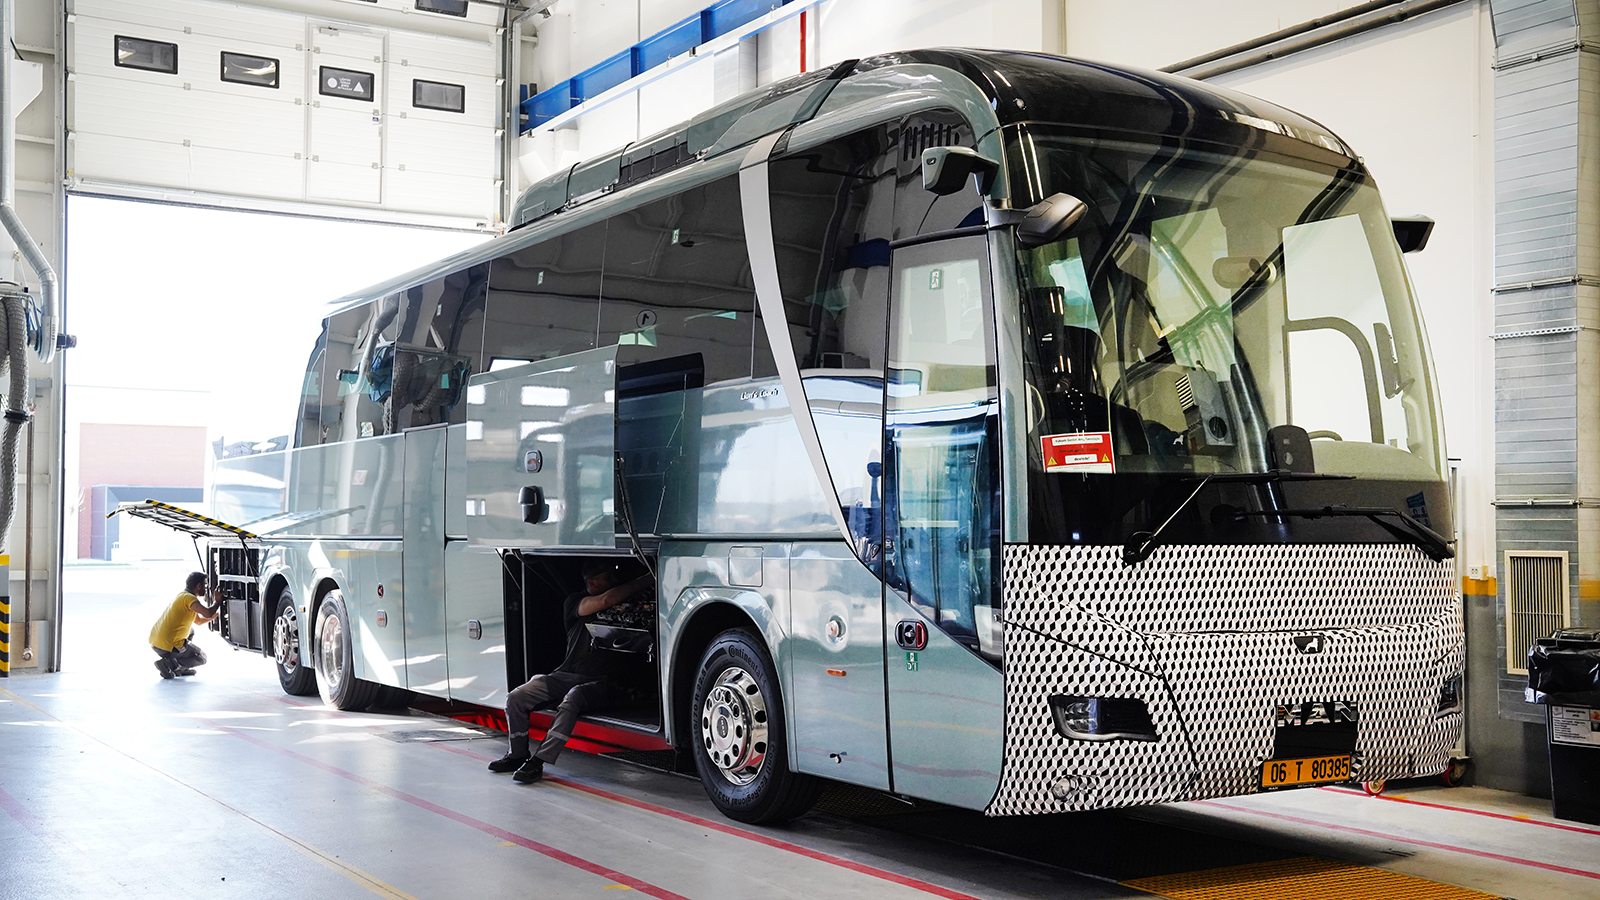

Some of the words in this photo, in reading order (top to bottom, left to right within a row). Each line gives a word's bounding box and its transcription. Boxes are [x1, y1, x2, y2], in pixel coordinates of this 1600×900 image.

[728, 644, 763, 681] Continental
[696, 668, 707, 692] 22.5
[694, 693, 700, 702] R
[1277, 701, 1357, 727] MAN
[1271, 763, 1287, 783] 06
[1296, 761, 1303, 781] T
[1311, 757, 1350, 779] 80385
[731, 775, 768, 806] EcoRegional
